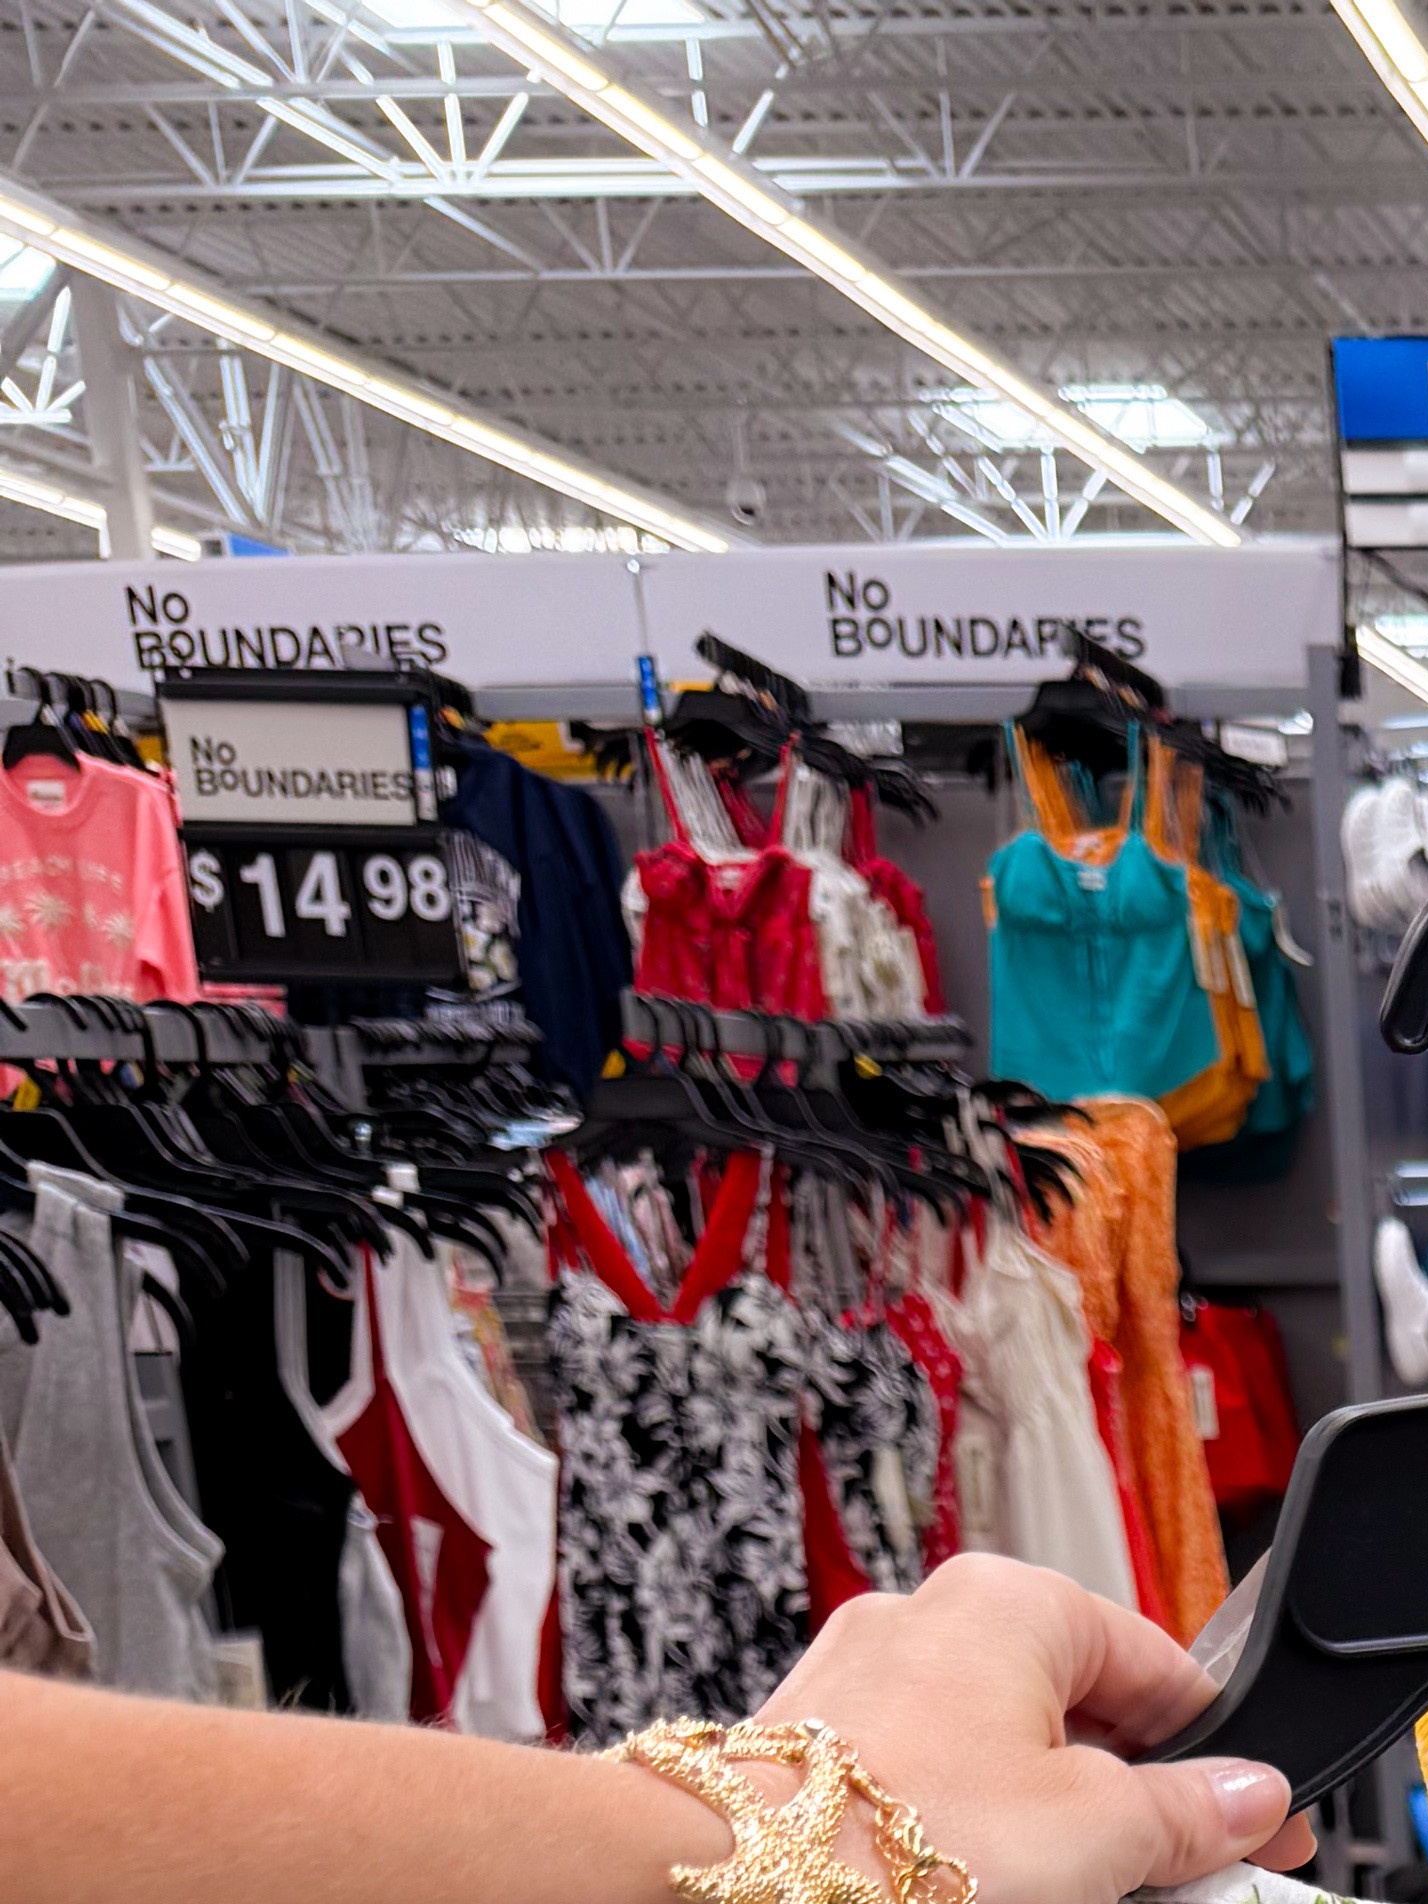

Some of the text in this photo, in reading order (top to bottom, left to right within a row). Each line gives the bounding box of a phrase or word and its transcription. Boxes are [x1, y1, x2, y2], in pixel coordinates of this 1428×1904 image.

[125, 583, 190, 626] No
[824, 569, 891, 612] No
[830, 615, 1147, 660] BOUNDARES
[189, 734, 238, 766] No
[195, 767, 414, 801] BOUNDARIES
